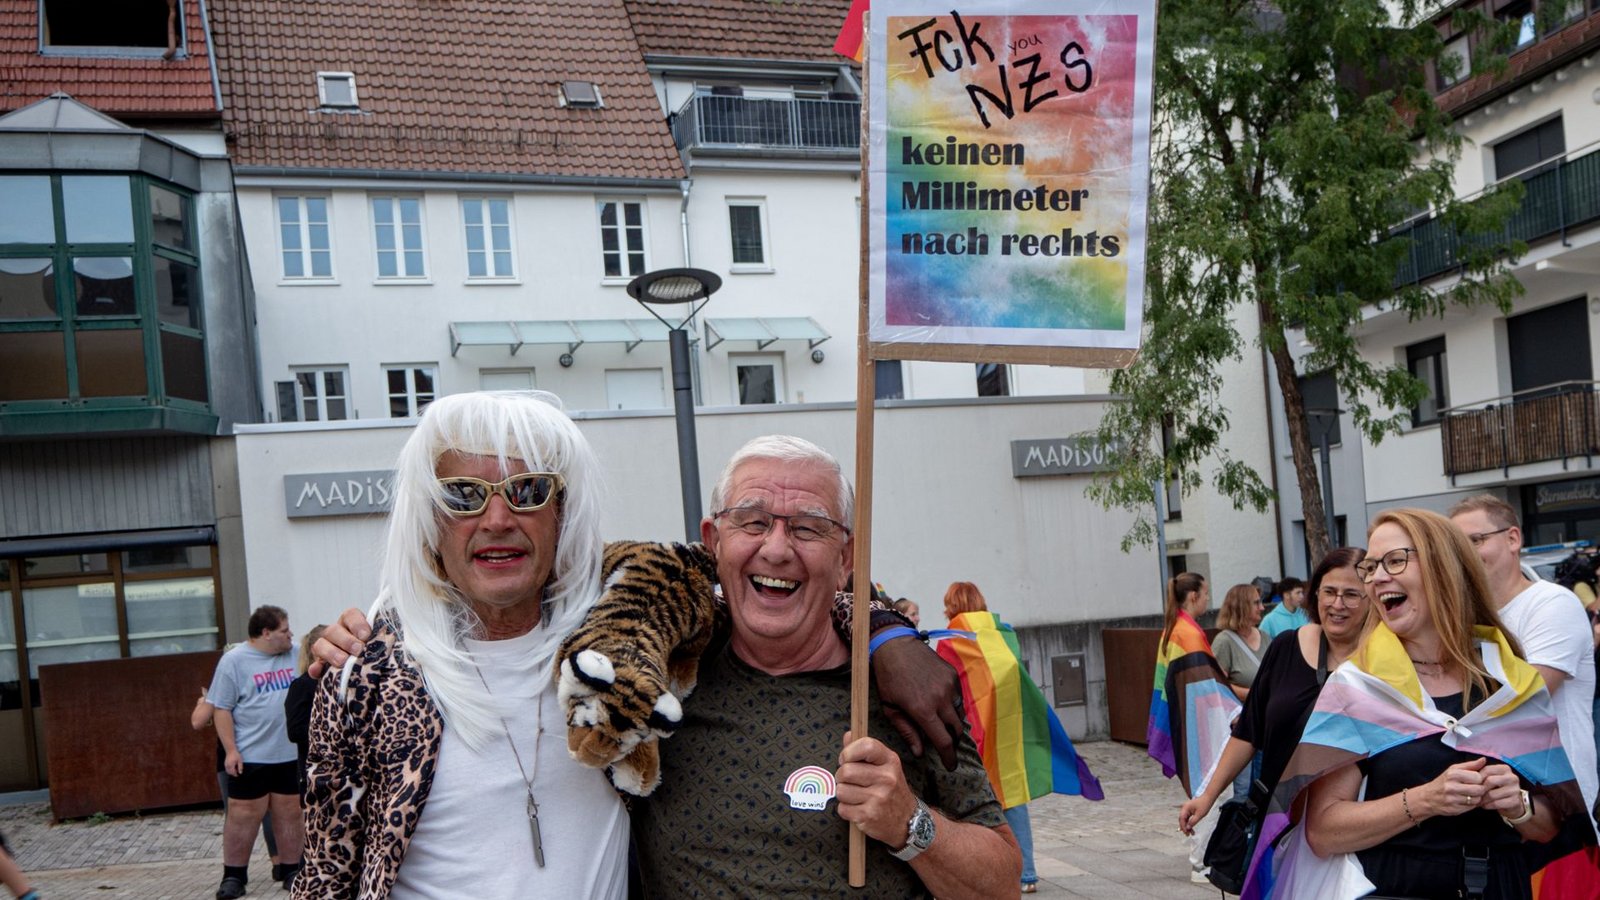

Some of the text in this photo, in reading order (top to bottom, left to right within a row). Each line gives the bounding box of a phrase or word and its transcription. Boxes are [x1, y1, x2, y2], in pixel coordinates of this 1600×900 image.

[1008, 34, 1043, 56] you
[965, 41, 1093, 129] NZS
[902, 136, 1025, 166] keinen
[902, 181, 1089, 212] Millimeter
[902, 226, 1121, 258] nach rechts
[253, 668, 297, 694] PRIDE
[791, 800, 825, 809] love wins
